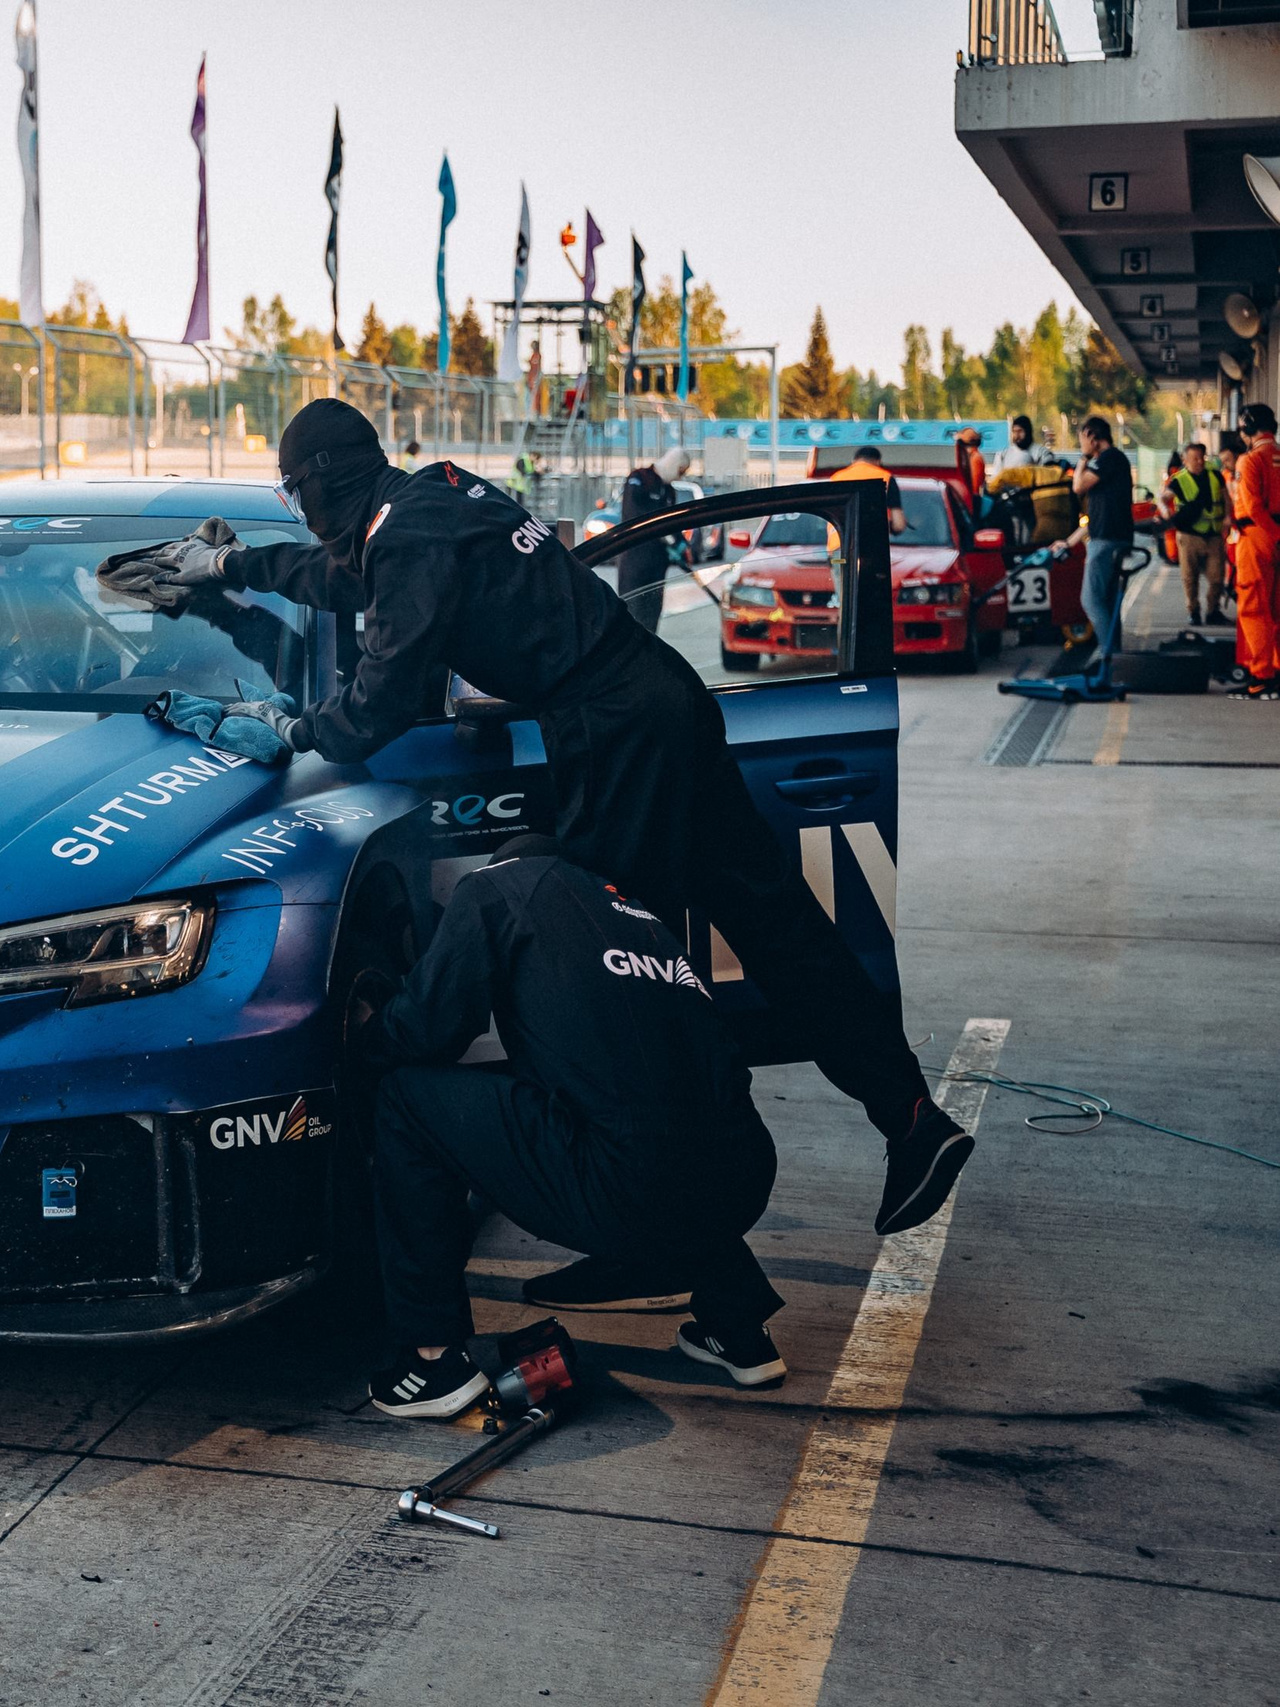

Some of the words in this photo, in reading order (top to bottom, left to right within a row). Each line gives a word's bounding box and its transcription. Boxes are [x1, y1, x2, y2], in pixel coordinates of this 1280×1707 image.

[1100, 180, 1116, 206] 6
[1129, 253, 1143, 272] 5
[512, 516, 551, 554] GNV
[1011, 577, 1047, 605] 23
[51, 746, 254, 866] SHTURMA
[221, 801, 375, 875] INFOCUS
[603, 949, 674, 983] GNV
[209, 1110, 287, 1150] GNV
[308, 1117, 321, 1126] OIL
[308, 1124, 332, 1137] GROUP
